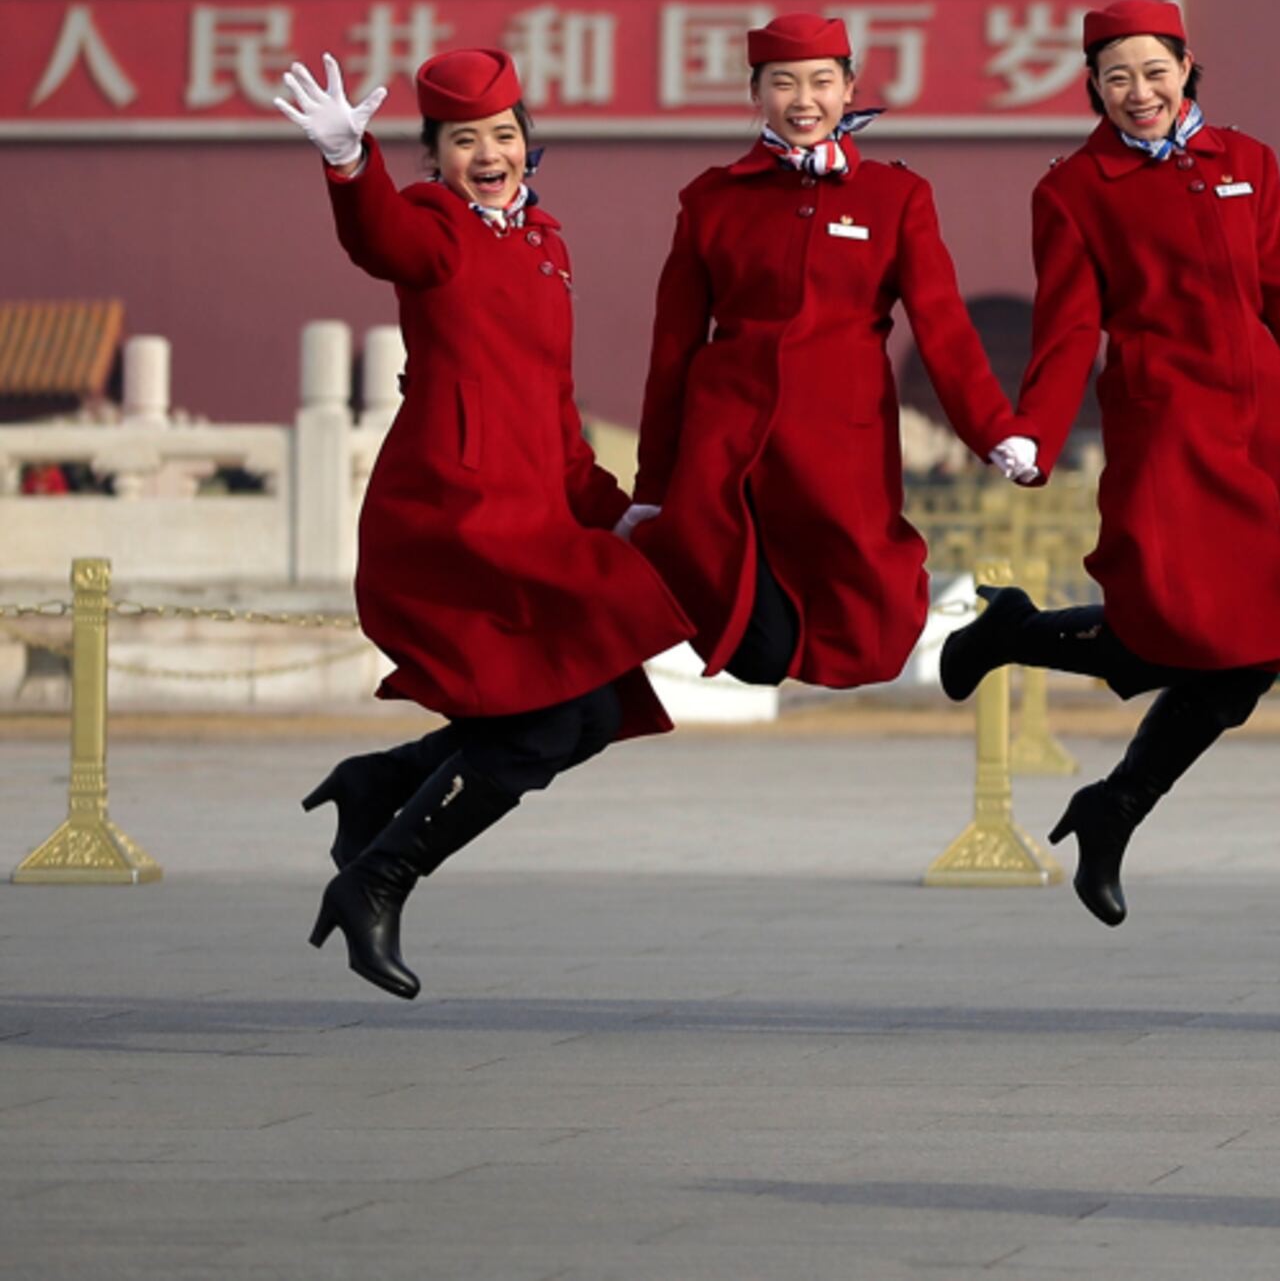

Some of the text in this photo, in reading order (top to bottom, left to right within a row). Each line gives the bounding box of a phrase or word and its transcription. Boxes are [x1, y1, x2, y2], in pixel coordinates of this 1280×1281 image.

[28, 1, 1087, 109] 人民共和国万岁
